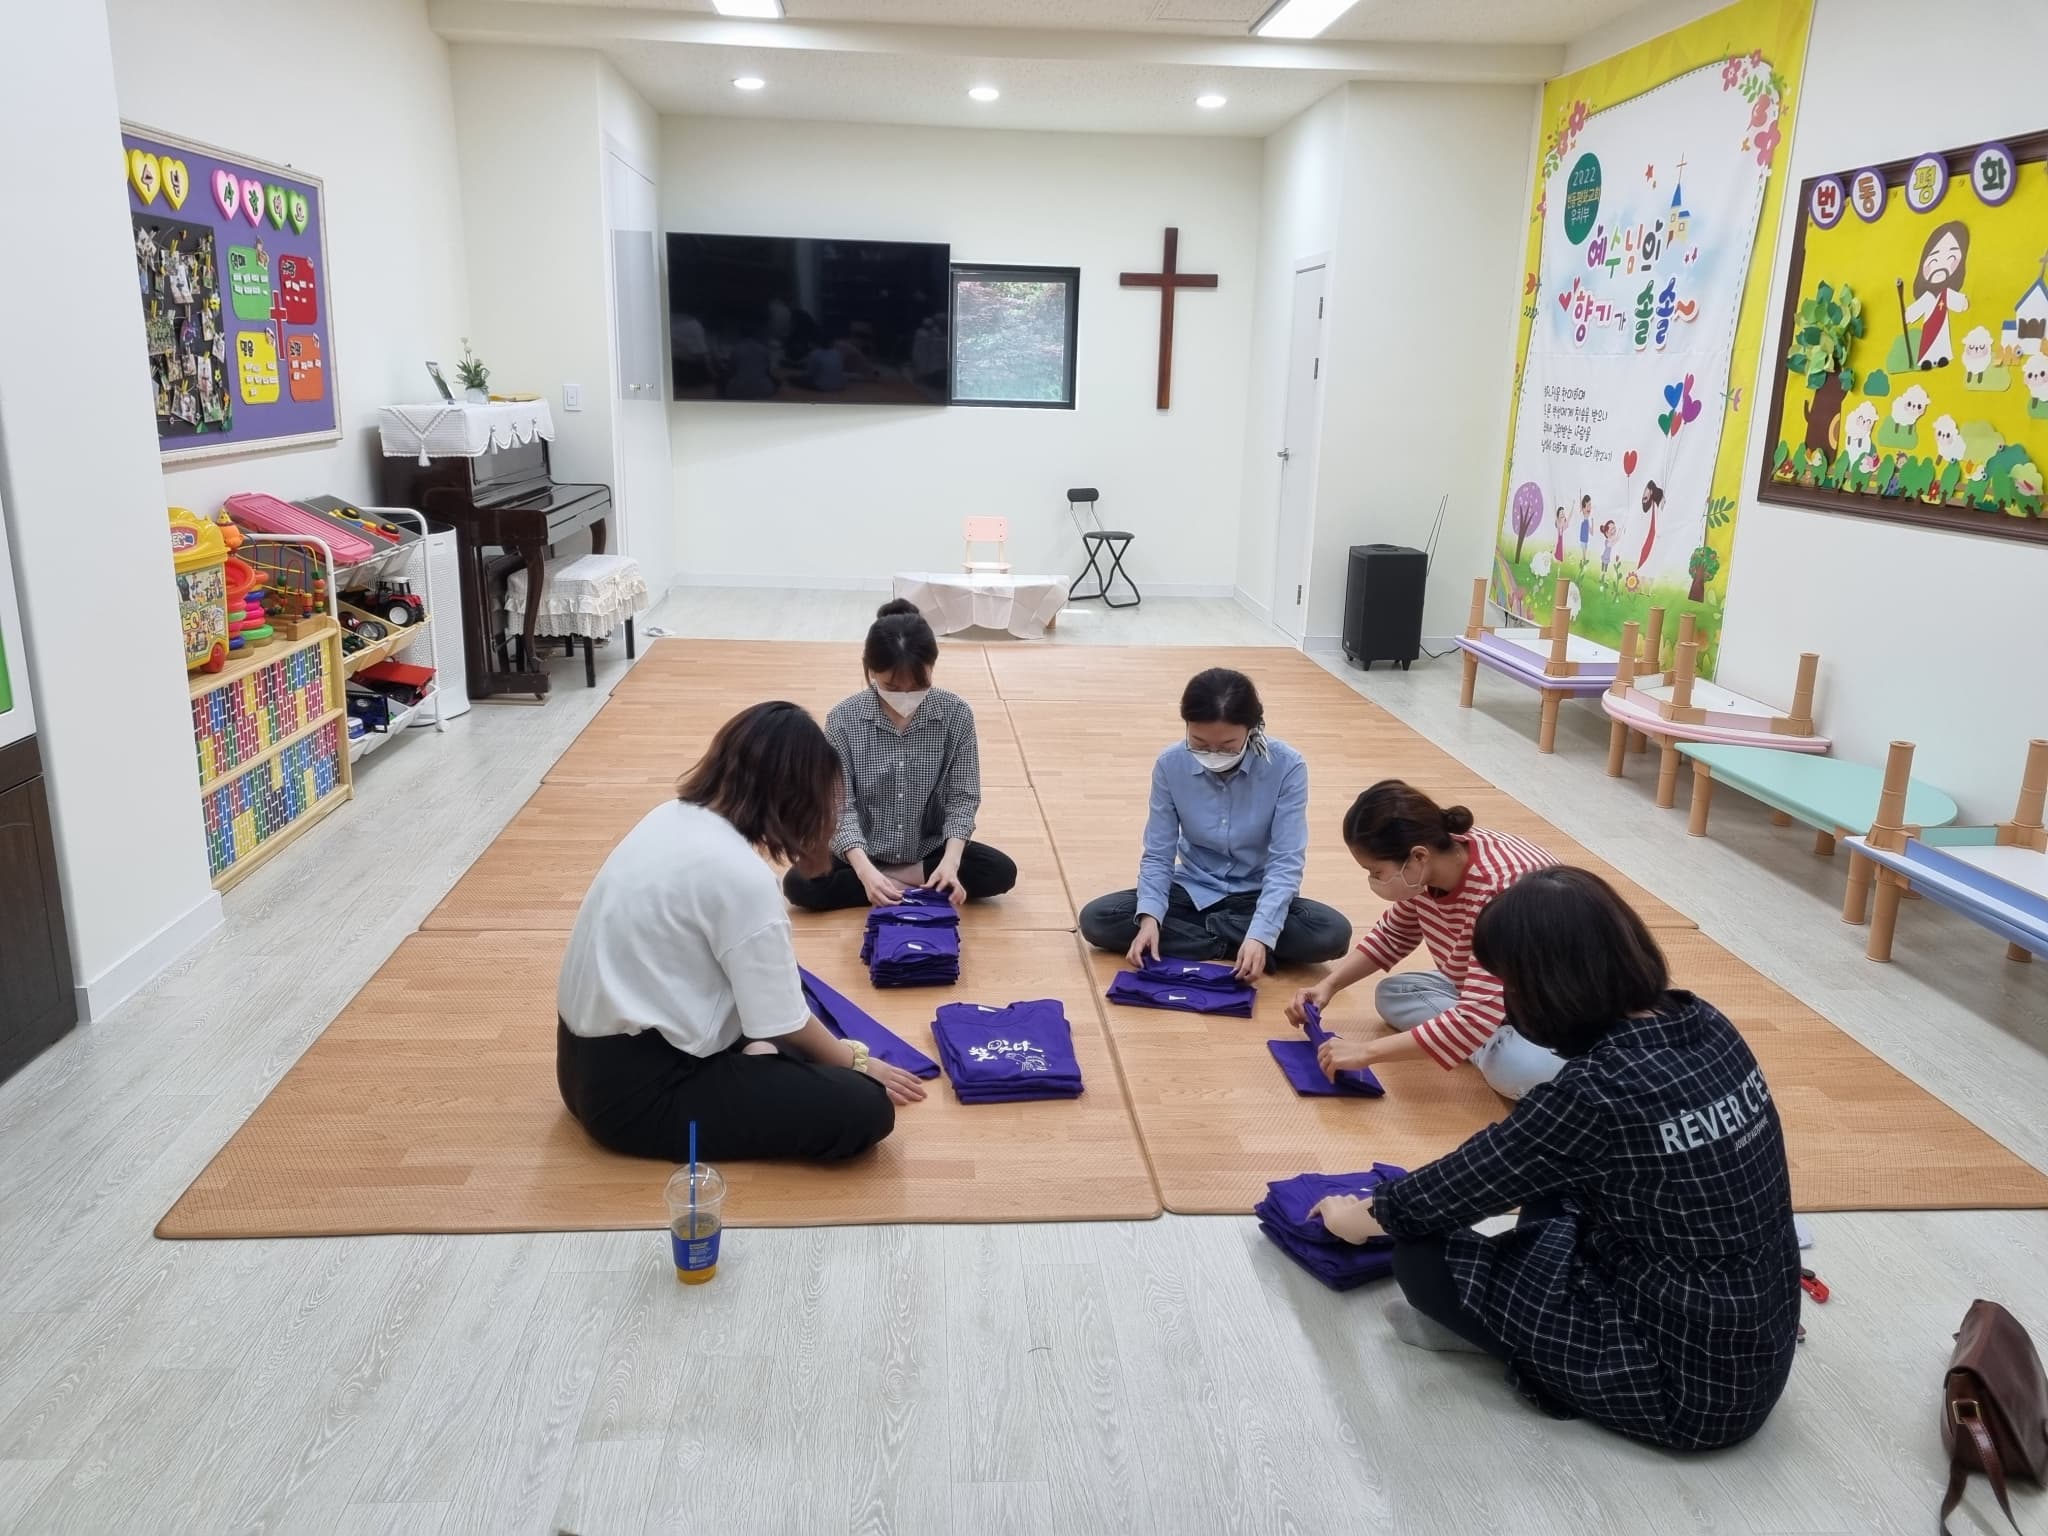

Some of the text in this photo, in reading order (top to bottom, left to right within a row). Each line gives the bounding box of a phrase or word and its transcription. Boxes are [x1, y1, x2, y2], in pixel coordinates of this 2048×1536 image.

[1572, 166, 1596, 187] 2022
[1587, 222, 1662, 279] 예수님의
[1574, 288, 1627, 342] 향기가
